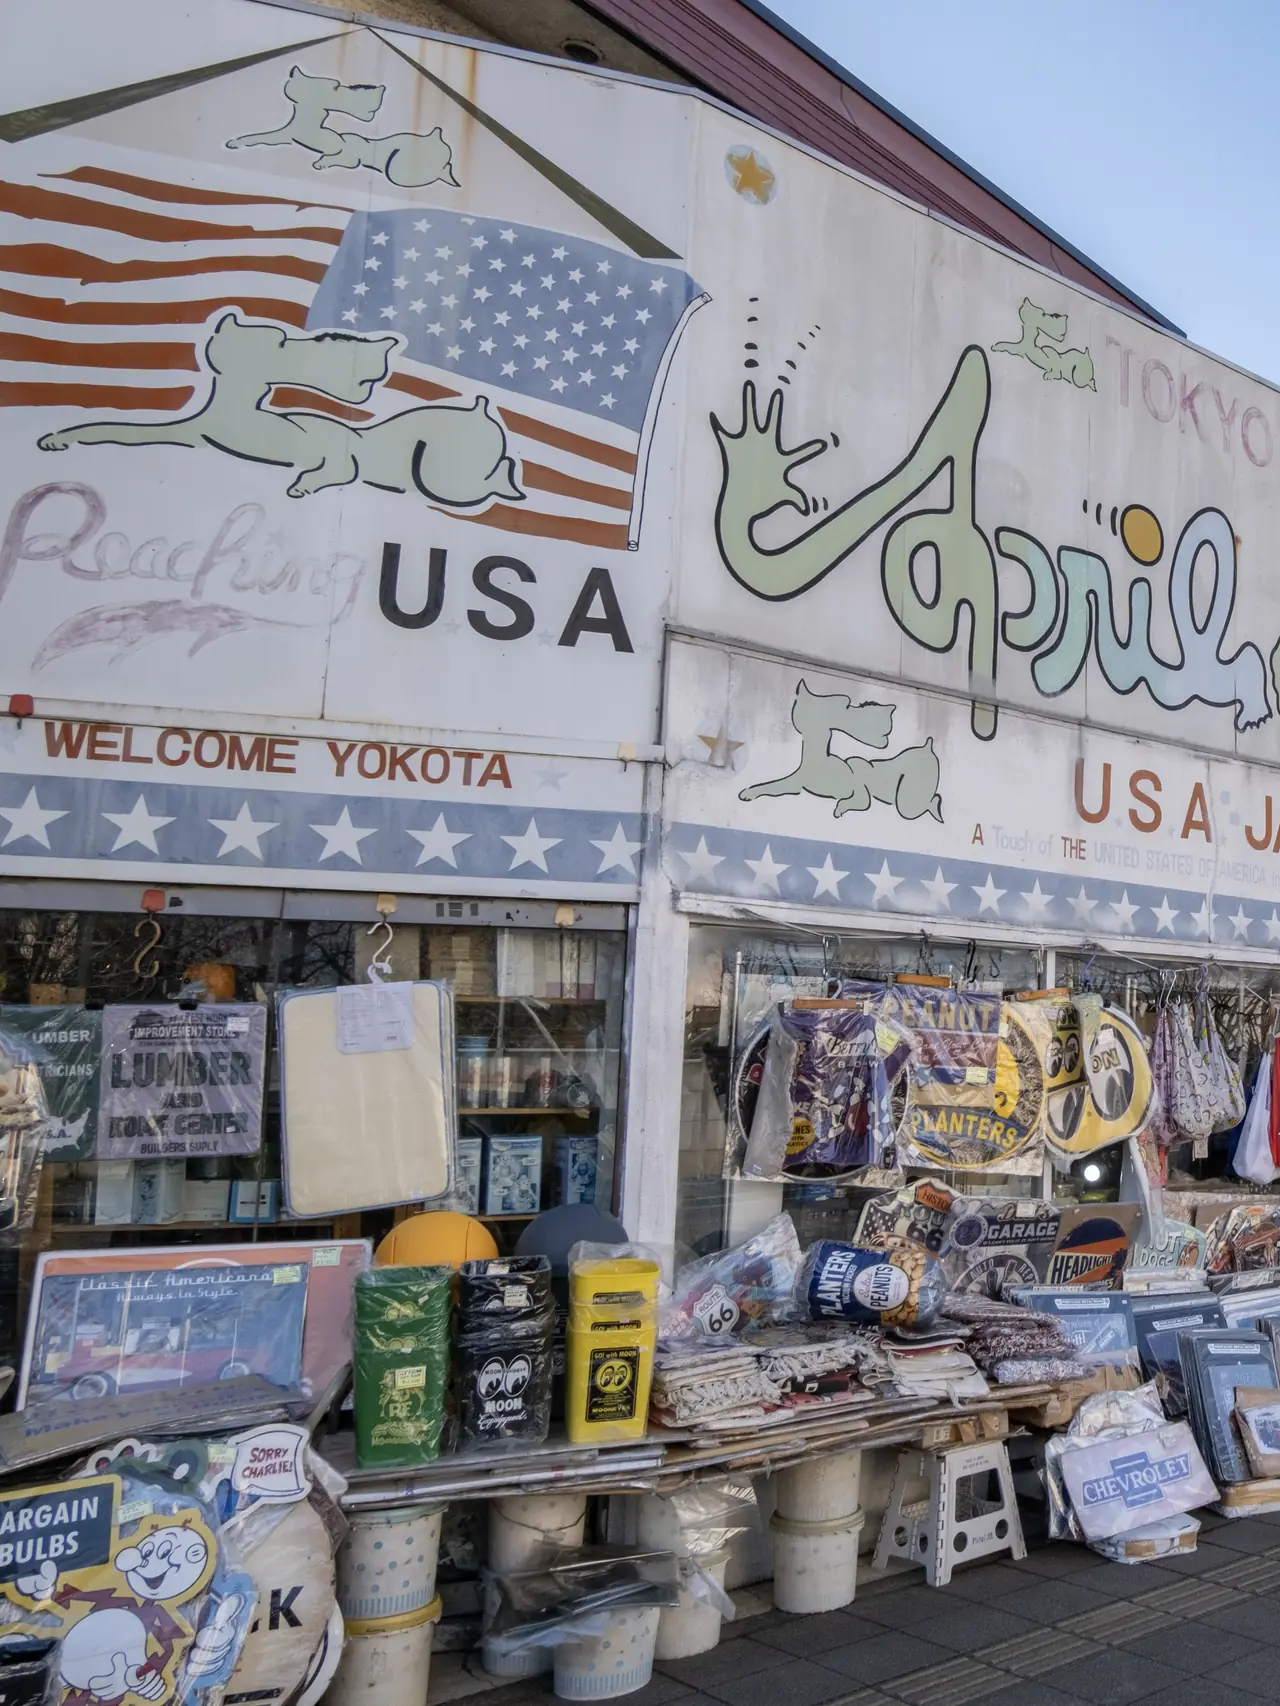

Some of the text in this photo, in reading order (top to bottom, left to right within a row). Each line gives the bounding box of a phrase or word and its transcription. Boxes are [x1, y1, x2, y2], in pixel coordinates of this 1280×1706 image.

[1105, 336, 1273, 468] TOKYO
[710, 344, 1272, 742] April
[378, 541, 635, 653] USA
[44, 720, 513, 789] WELCOME YOKOTA
[1073, 757, 1213, 844] USA
[972, 823, 984, 846] A
[992, 824, 1034, 853] Touch
[1038, 834, 1053, 856] of
[1061, 836, 1087, 861] THE
[1094, 838, 1140, 869] UNITED
[1145, 850, 1194, 879] STATES
[1199, 857, 1214, 879] OF
[1218, 860, 1268, 888] AMERICA
[31, 1028, 92, 1045] UMBER
[134, 1026, 204, 1038] IMPROVEMENT
[111, 1051, 254, 1089] LUMBER
[1091, 1048, 1120, 1073] ON
[174, 1112, 249, 1136] CENTER
[911, 1110, 1018, 1149] PLANTERS
[922, 1190, 951, 1210] HISTO
[987, 1222, 1059, 1240] GARAGE
[79, 1271, 273, 1291] Classic Americana
[816, 1250, 856, 1317] PLANTERS
[969, 1258, 994, 1279] AUTO
[1051, 1254, 1113, 1284] HEADLIGHT
[698, 1291, 721, 1313] ROUTE
[870, 1266, 894, 1308] PEANUTS
[708, 1301, 735, 1333] 66
[594, 1352, 605, 1360] GO!
[619, 1350, 637, 1358] MOON
[485, 1397, 523, 1413] MOON
[592, 1405, 631, 1414] MOONEYES
[241, 1460, 294, 1479] CHARLIE!
[249, 1446, 289, 1463] SORRY
[1082, 1453, 1190, 1503] CHEVROLET
[0, 1495, 99, 1534] ARGAIN
[0, 1530, 80, 1567] BULBS
[258, 1586, 305, 1631] K
